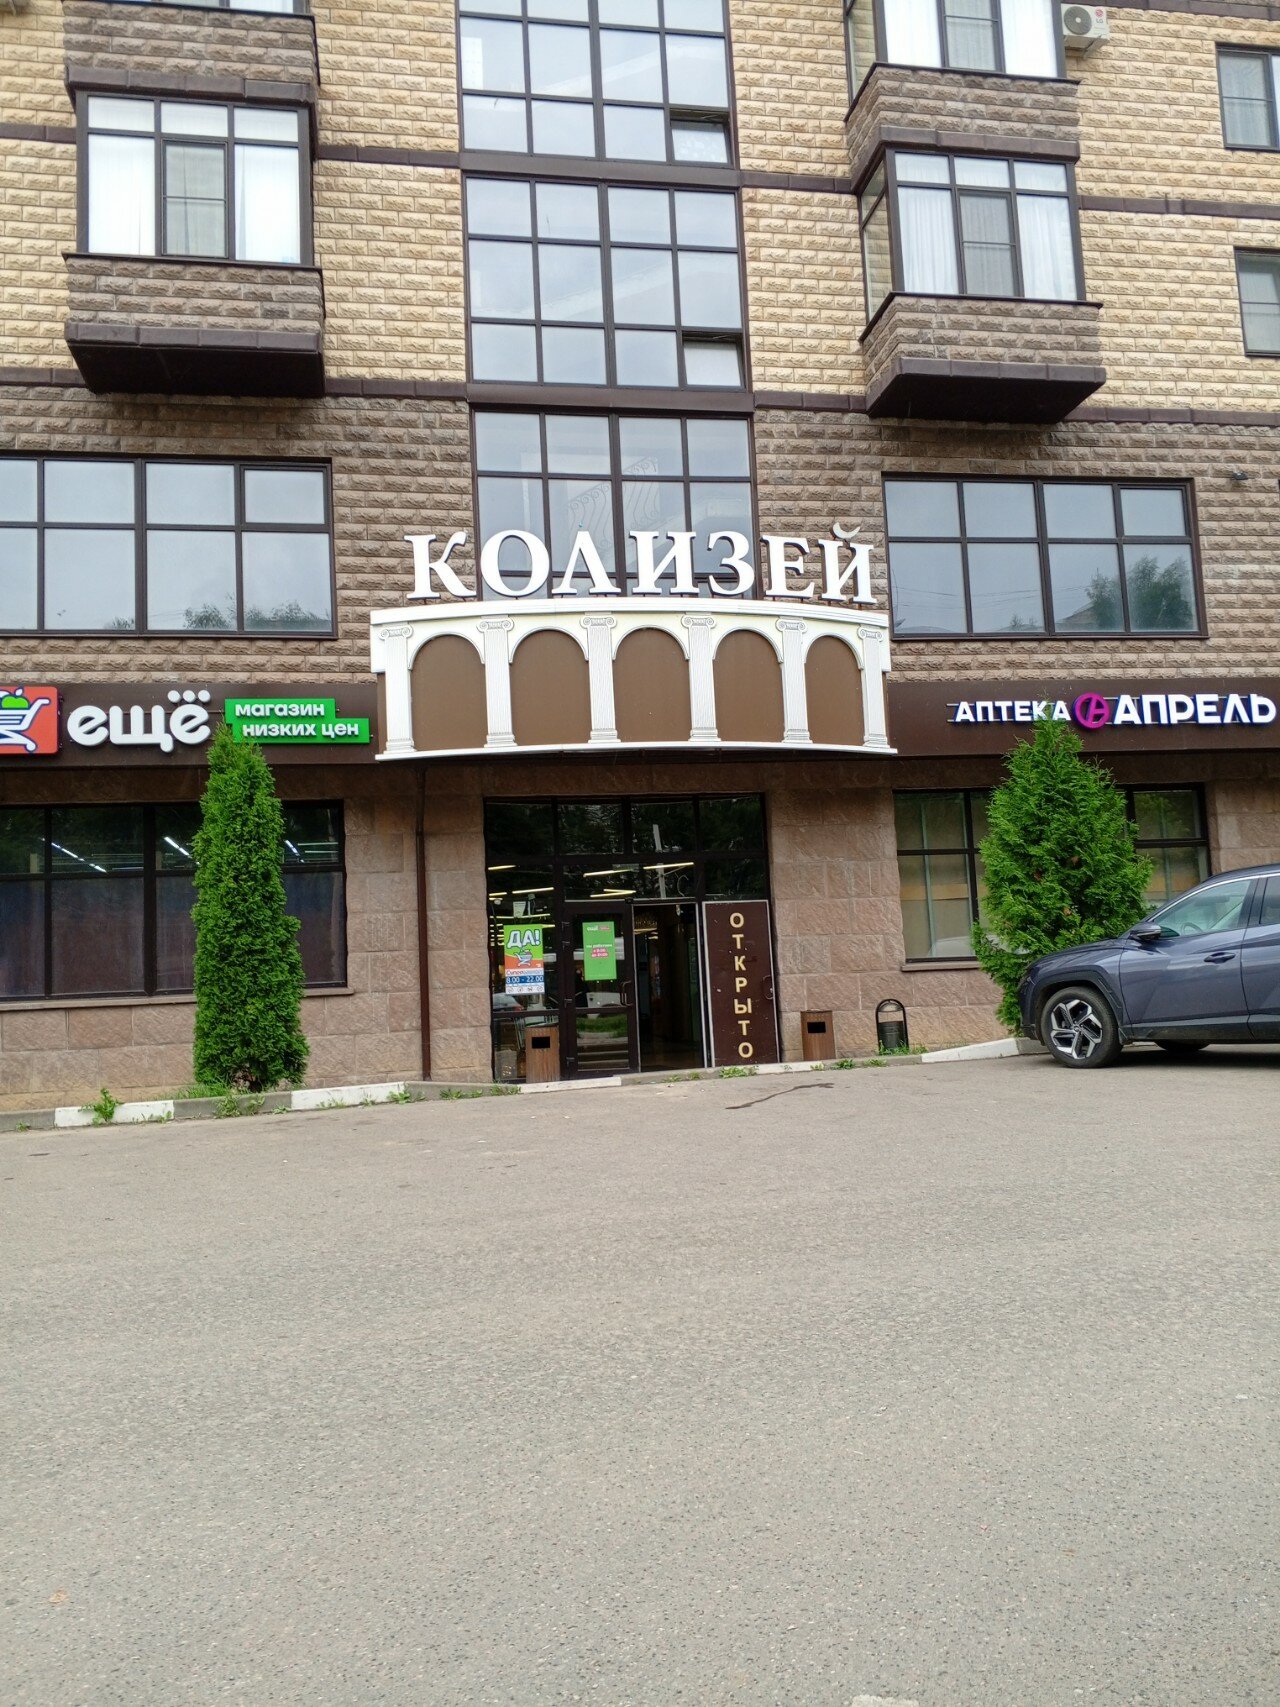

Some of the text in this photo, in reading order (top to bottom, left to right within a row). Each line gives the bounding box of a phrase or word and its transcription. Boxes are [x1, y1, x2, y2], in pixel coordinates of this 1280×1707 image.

[403, 521, 878, 605] КОЛИЗЕЙ
[67, 689, 211, 753] ещё
[234, 702, 325, 718] магазин
[955, 693, 1278, 725] АПТЕКА АПРЕЛЬ
[242, 721, 359, 739] низких цен
[506, 929, 541, 949] ДА!
[729, 912, 754, 1059] ОТКРЫТО
